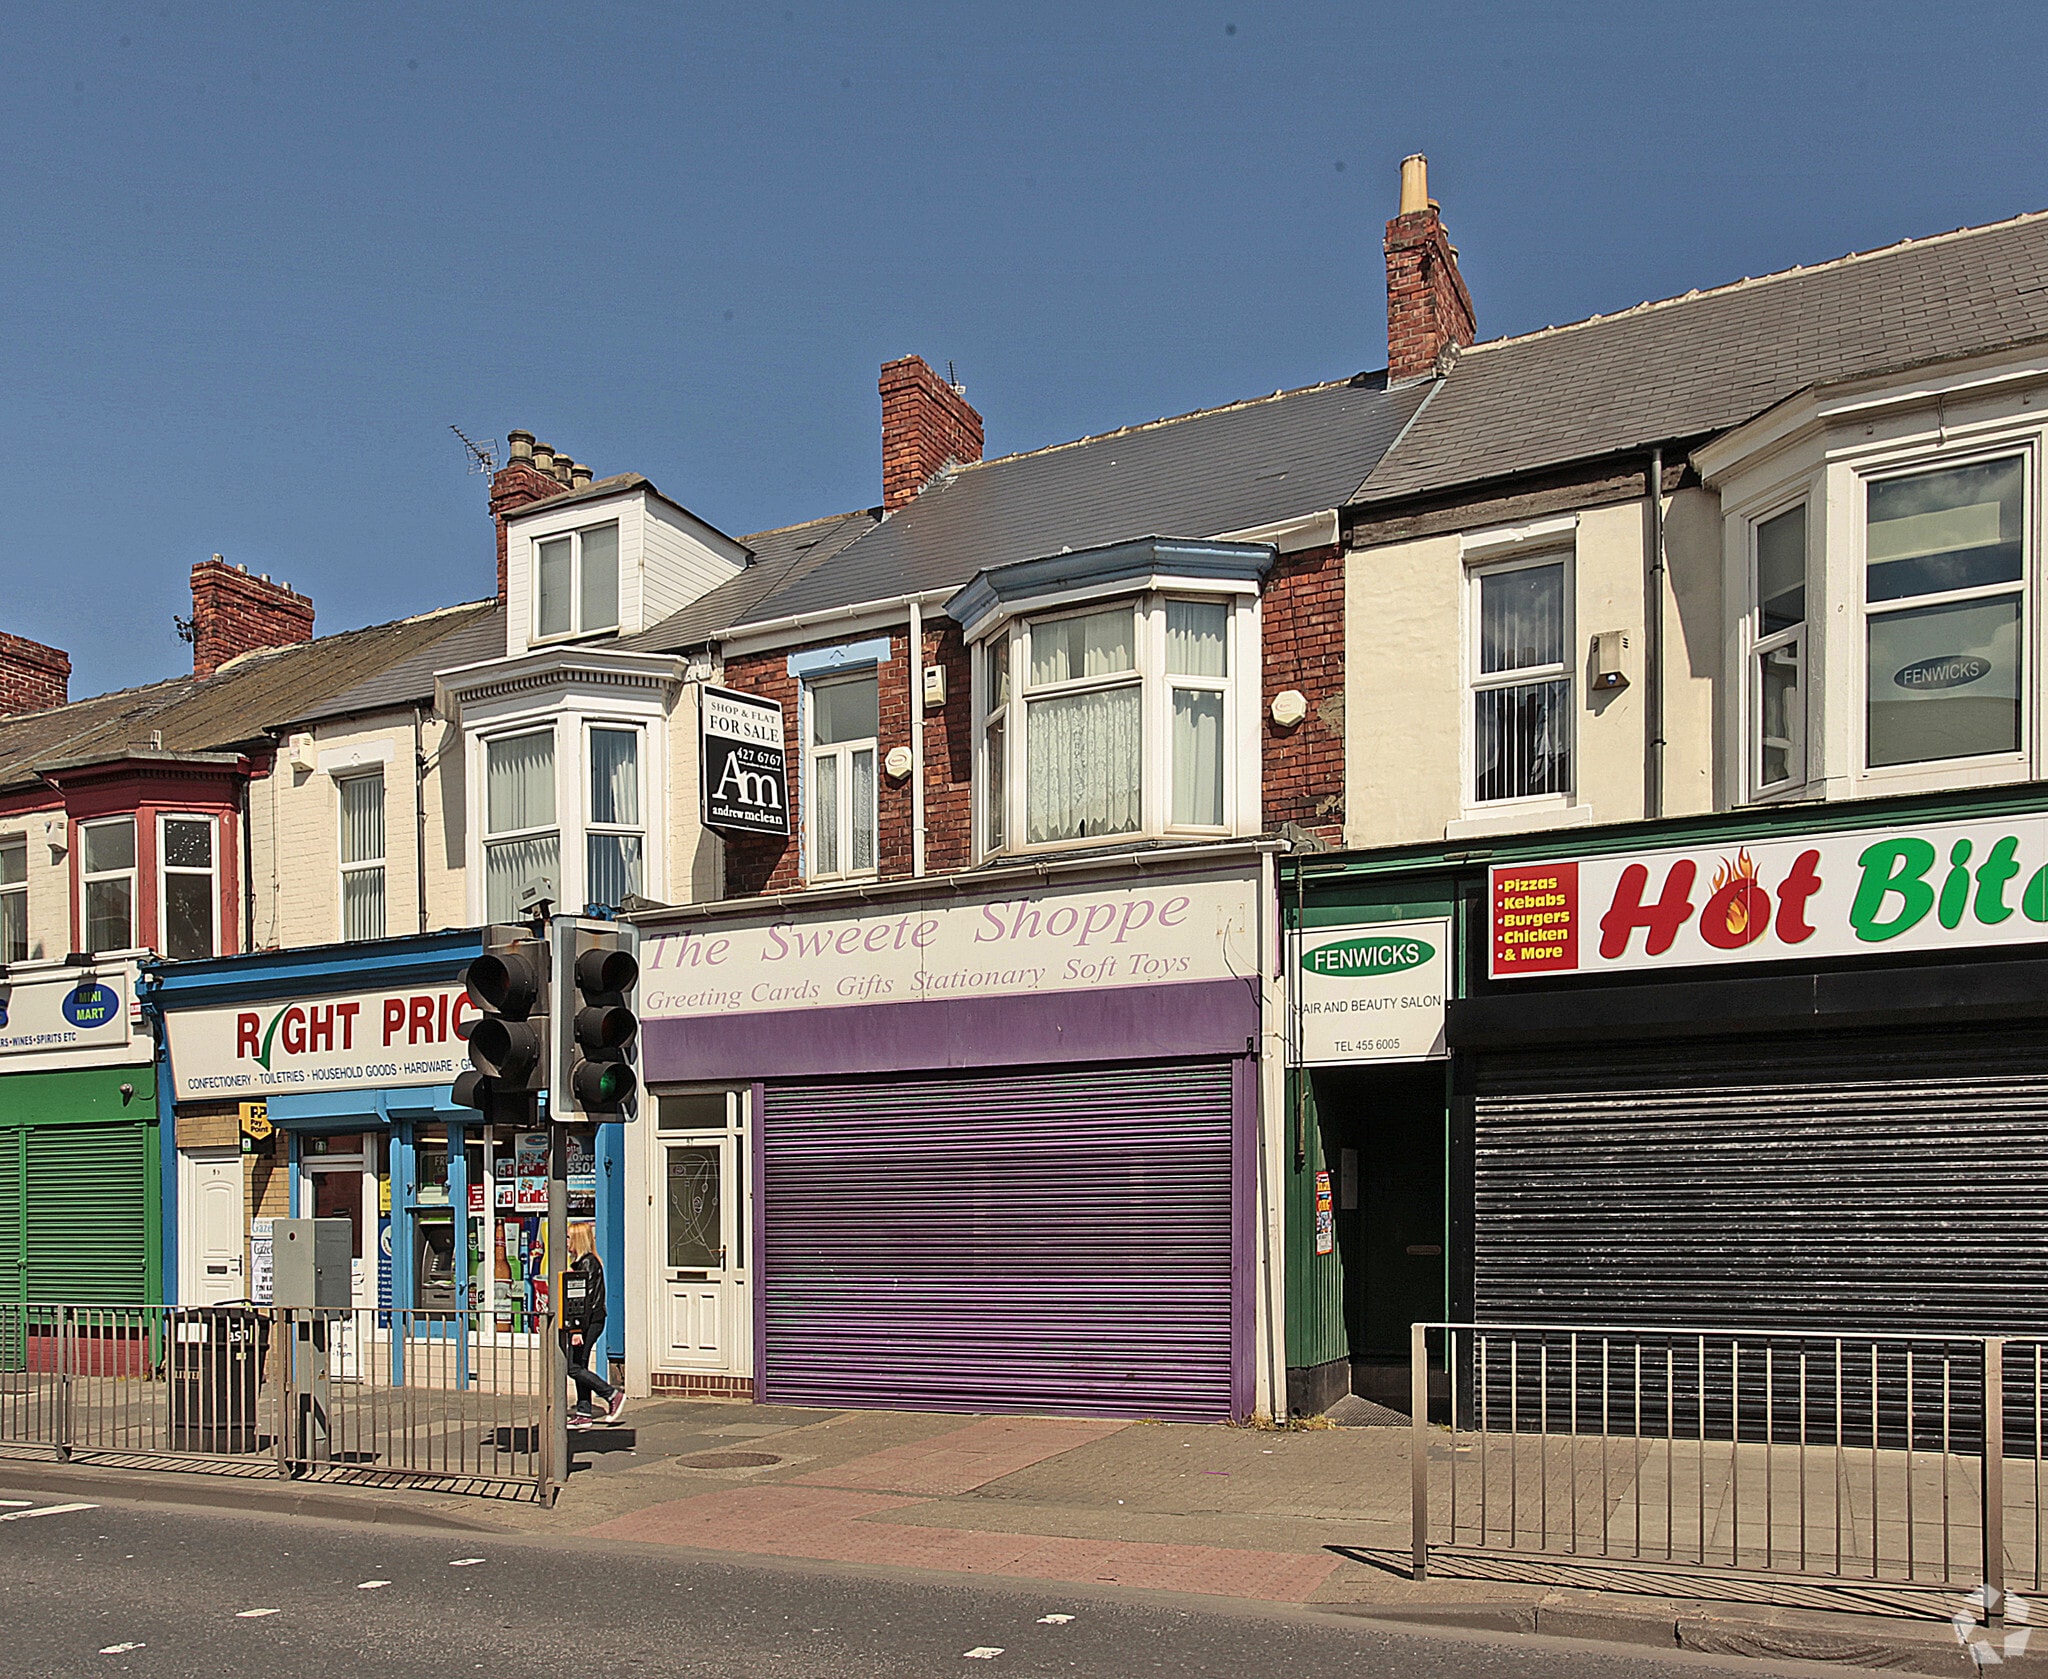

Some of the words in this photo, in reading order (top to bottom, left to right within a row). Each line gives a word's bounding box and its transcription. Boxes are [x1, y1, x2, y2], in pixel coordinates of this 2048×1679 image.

[1903, 661, 1980, 685] FENWICKS
[711, 701, 739, 716] SHOP
[741, 710, 749, 718] &
[751, 711, 776, 724] FLAT
[710, 715, 740, 734] FOR
[744, 722, 779, 743] SALE
[736, 747, 754, 761] 427
[757, 752, 781, 767] 6767
[712, 750, 782, 809] Am
[1504, 877, 1558, 893] Pizzas
[1504, 893, 1566, 910] Kebabs
[1598, 848, 1822, 960] Hot
[1504, 911, 1570, 927] Burgers
[647, 929, 731, 970] The
[761, 915, 939, 962] Sweete
[974, 896, 1190, 947] Shoppe
[1504, 928, 1568, 944] Chicken
[1314, 942, 1420, 971] FENWICKS
[1504, 948, 1516, 961] &
[1521, 946, 1563, 960] More
[646, 988, 743, 1009] Greeting
[751, 979, 821, 1003] Cards
[836, 974, 894, 1000] Gifts
[910, 967, 1046, 991] Stationary
[1063, 955, 1119, 984] Soft
[1129, 953, 1190, 979] Toys
[79, 990, 102, 1003] MINI
[1298, 1002, 1322, 1015] AIR
[1324, 1001, 1348, 1013] AND
[1352, 997, 1398, 1012] BEAUTY
[1401, 995, 1441, 1009] SALON
[76, 1007, 105, 1021] MART
[63, 1031, 77, 1042] ETC
[1334, 1040, 1353, 1052] TEL
[1356, 1039, 1374, 1051] 455
[1376, 1038, 1400, 1050] 6005
[188, 1074, 252, 1090] CONFECTIONERY
[259, 1070, 305, 1085] TOILETRIES
[312, 1065, 364, 1081] HOUSEHOLD
[366, 1063, 397, 1078] GOODS
[404, 1059, 453, 1074] HARDWARE
